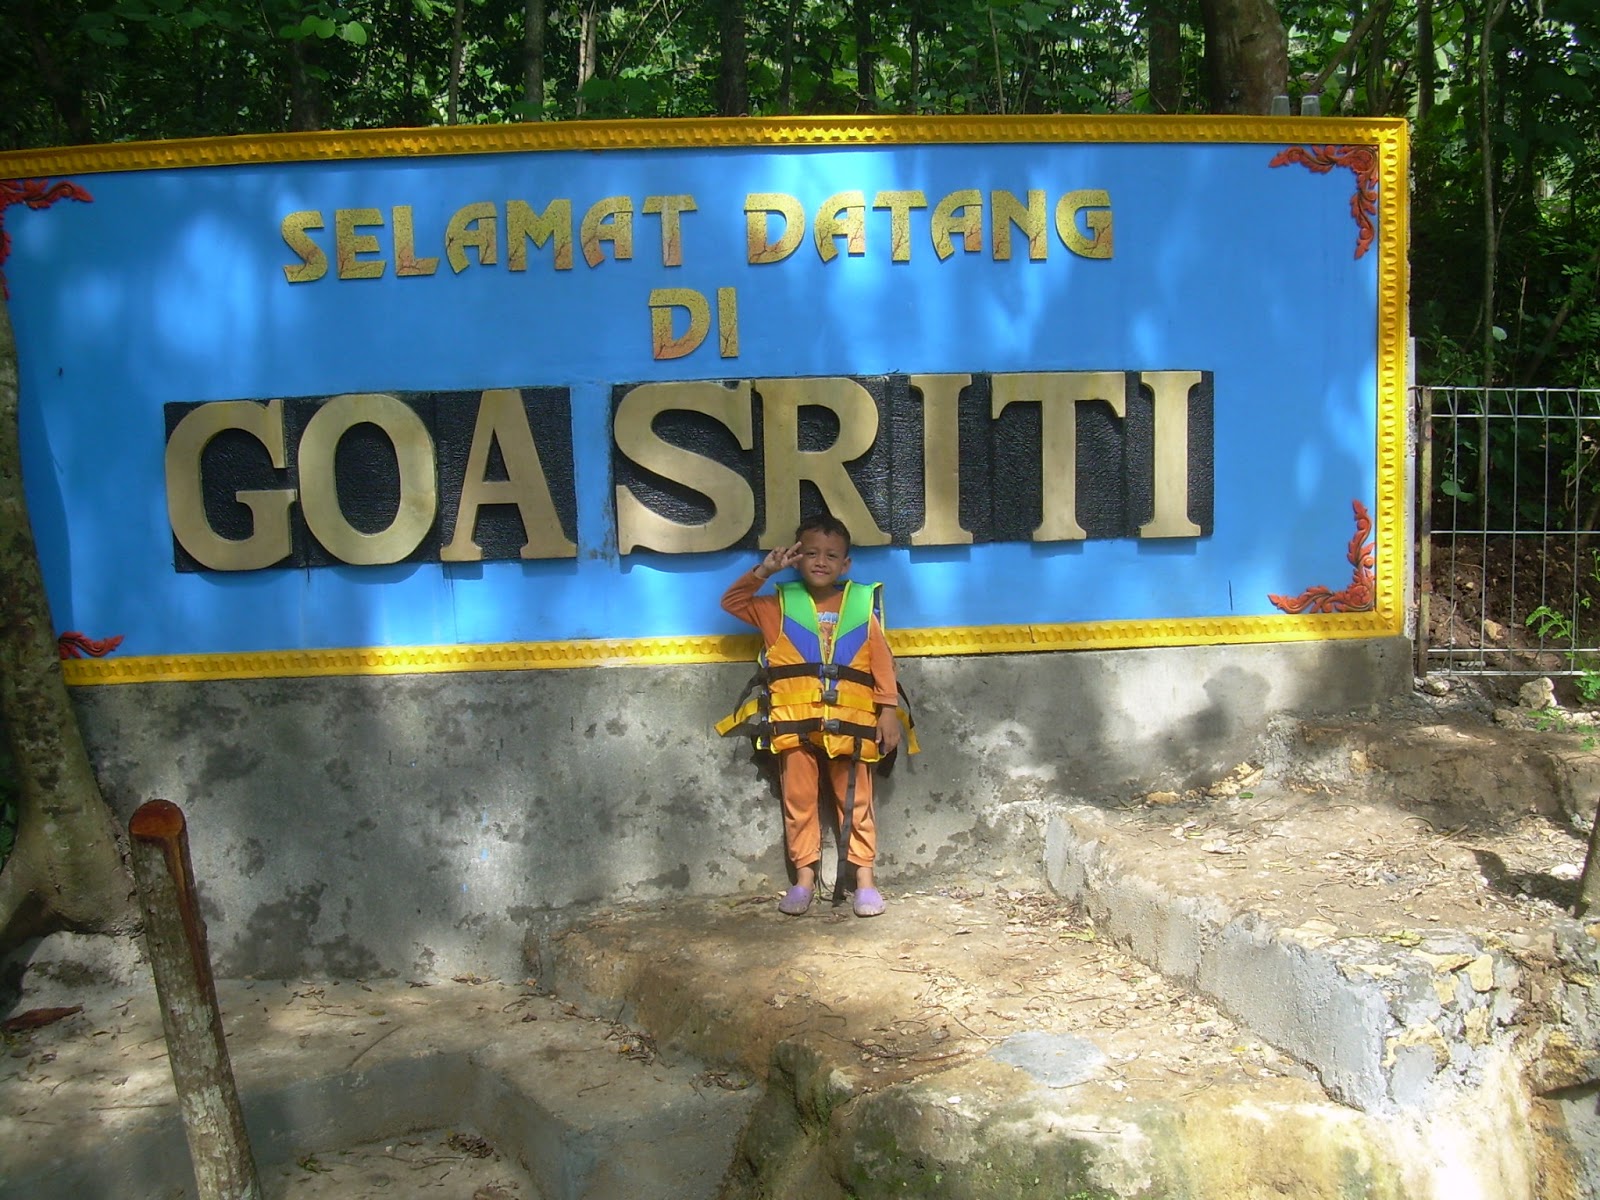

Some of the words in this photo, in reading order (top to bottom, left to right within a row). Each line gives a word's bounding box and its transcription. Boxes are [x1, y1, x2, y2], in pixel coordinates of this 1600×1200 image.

[281, 194, 697, 283] SELAMAT
[743, 189, 1114, 264] DATANG
[649, 287, 738, 360] DI
[165, 389, 578, 571] GOA
[614, 371, 1202, 555] SRITI
